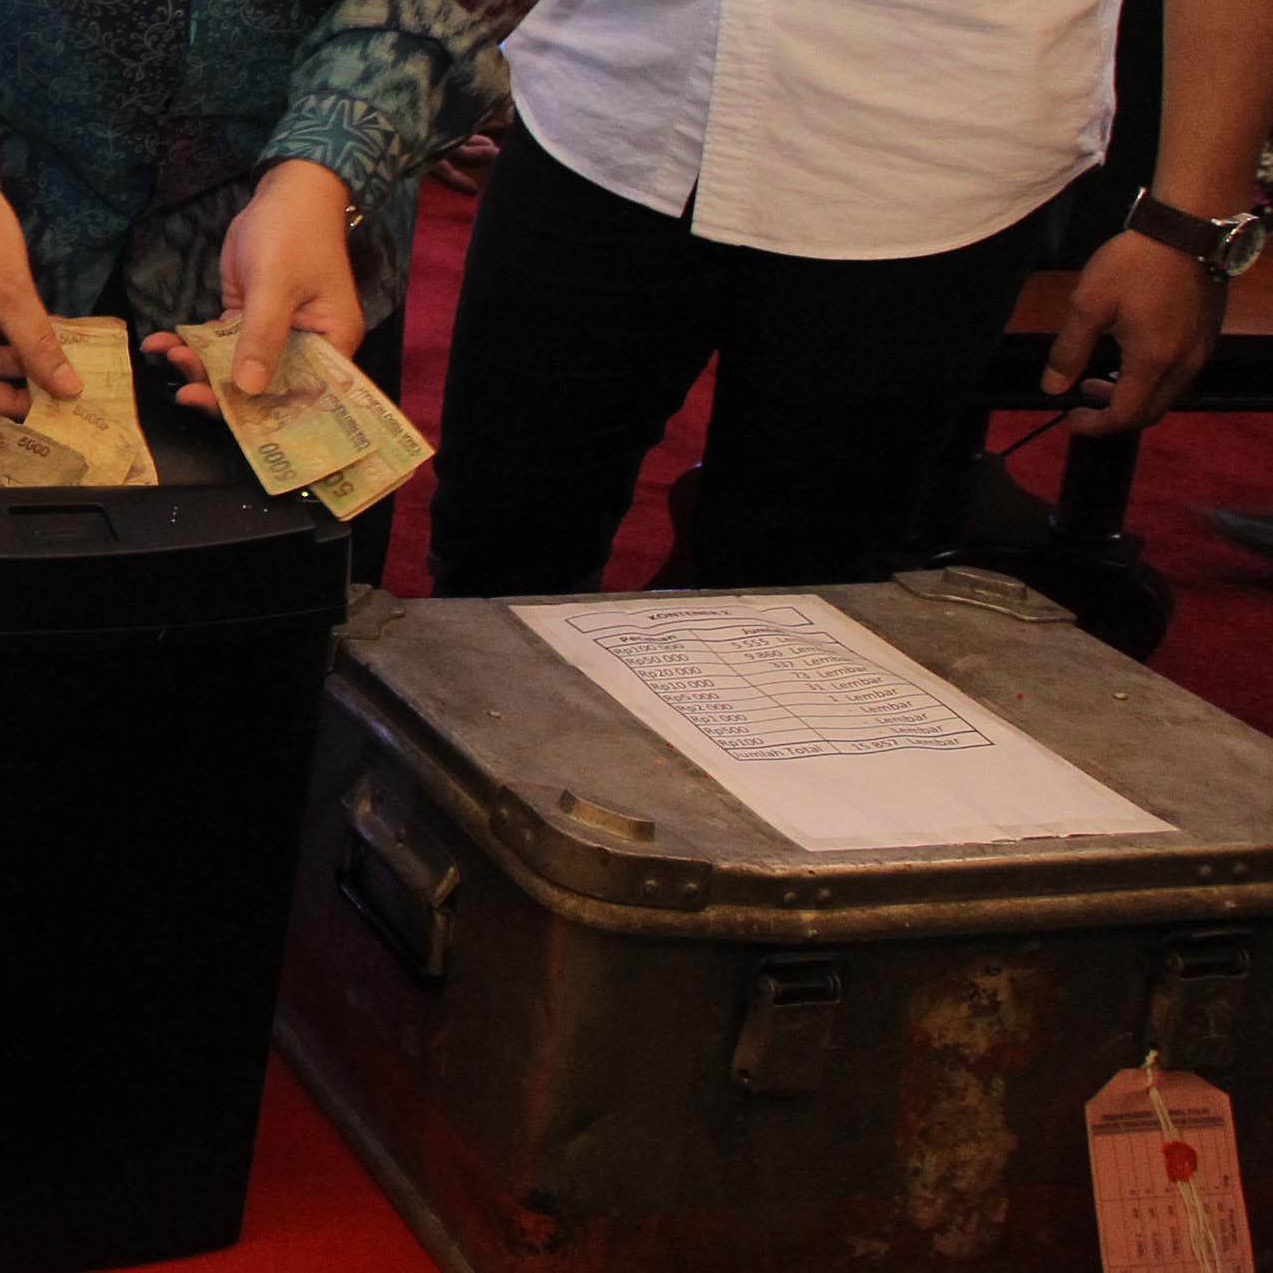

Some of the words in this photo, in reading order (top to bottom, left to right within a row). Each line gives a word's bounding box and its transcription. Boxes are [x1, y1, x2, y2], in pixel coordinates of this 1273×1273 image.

[17, 435, 51, 458] 5000
[830, 676, 884, 691] Lembar
[845, 687, 897, 702] Lembar
[859, 700, 913, 714] Lembar
[786, 745, 824, 755] Total
